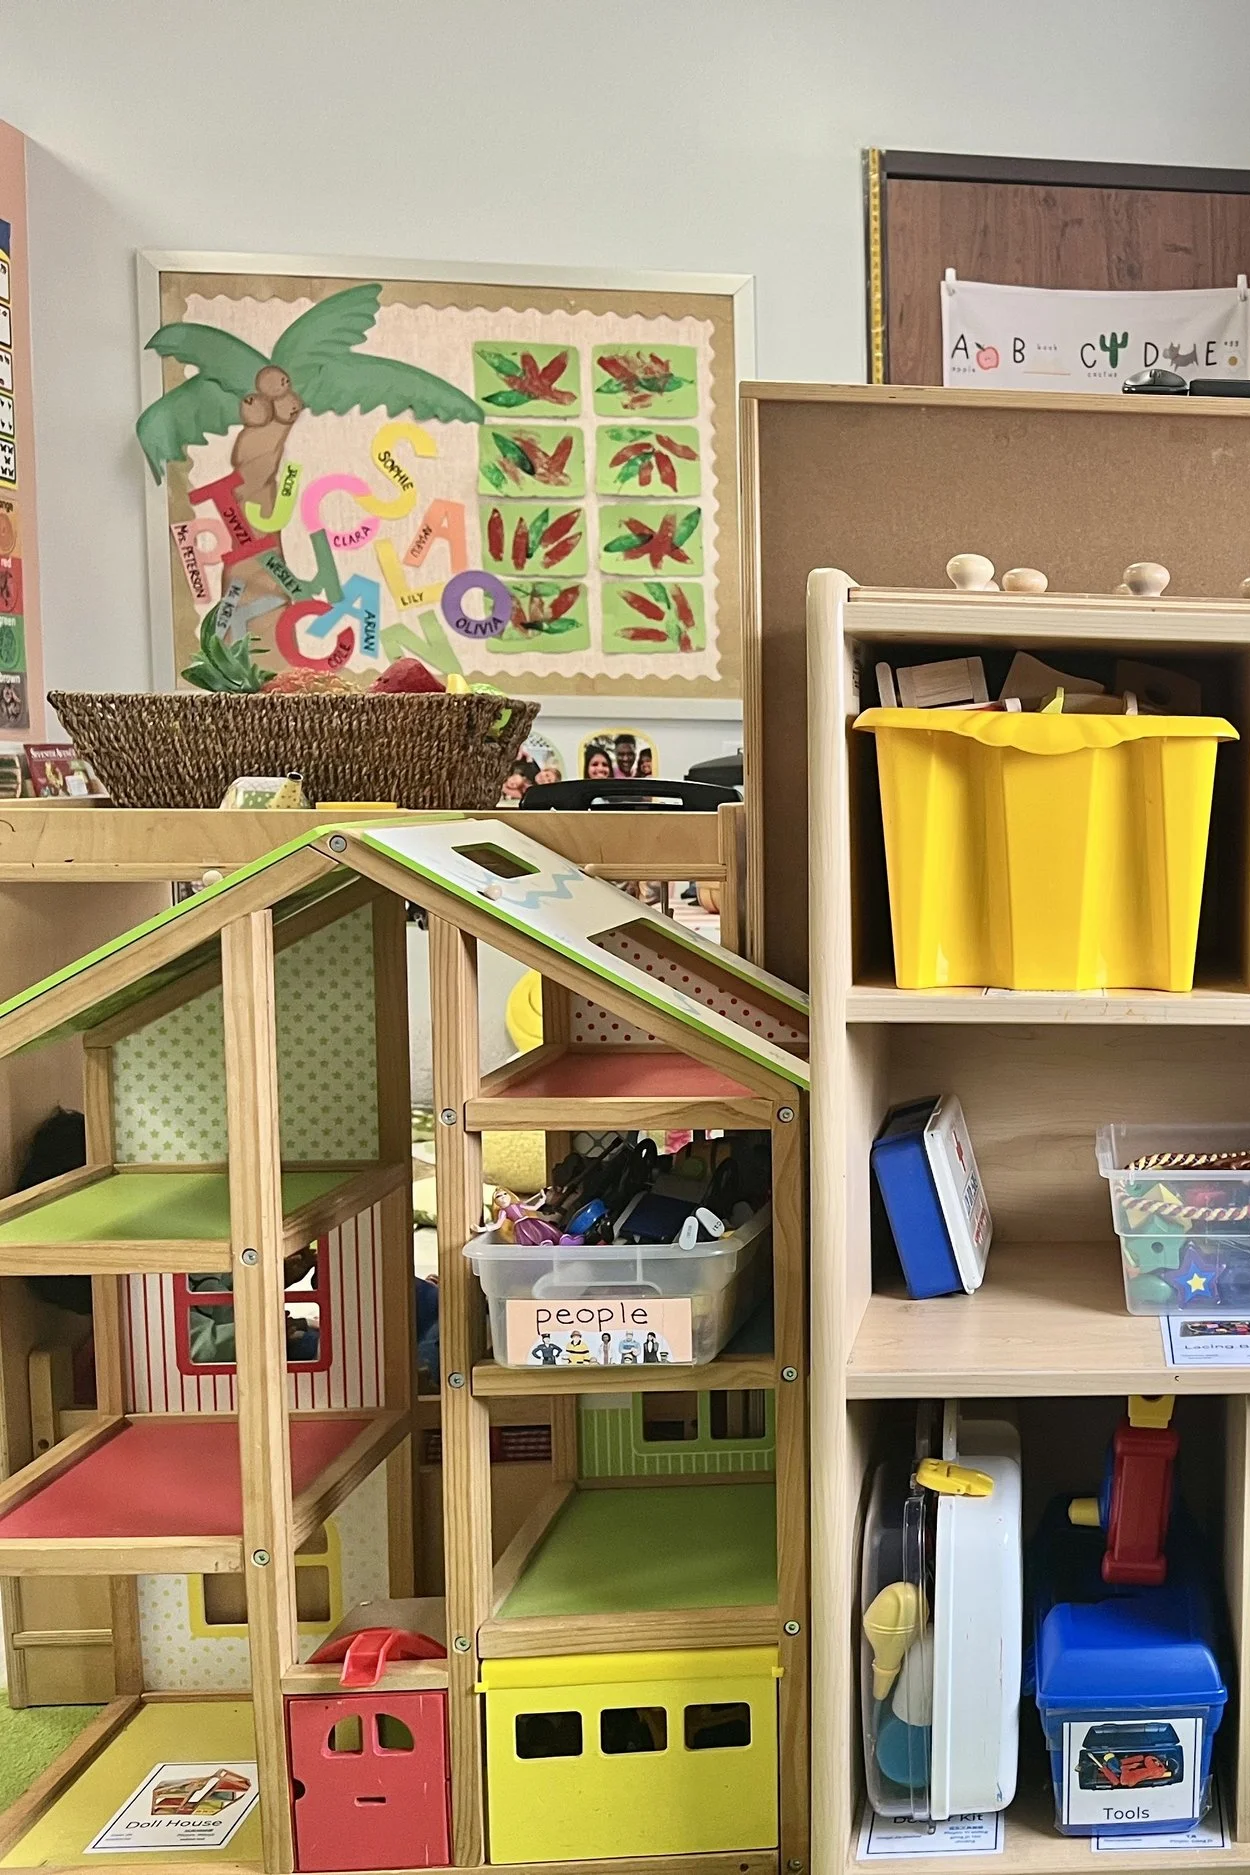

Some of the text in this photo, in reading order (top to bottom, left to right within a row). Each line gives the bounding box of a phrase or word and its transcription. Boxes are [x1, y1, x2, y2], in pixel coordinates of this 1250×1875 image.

[951, 334, 969, 359] A
[1013, 337, 1025, 364] B
[1080, 343, 1097, 369] C
[1144, 342, 1159, 367] D
[1205, 341, 1217, 366] E
[377, 450, 414, 491] SOPHIE
[333, 525, 372, 548] CLARA
[265, 556, 302, 594] WESLEY
[400, 592, 425, 606] LILY
[455, 616, 505, 636] OLIVIA
[328, 643, 351, 669] COLE
[536, 1302, 648, 1335] people
[125, 1820, 163, 1829] Doll
[1103, 1807, 1150, 1820] Tools
